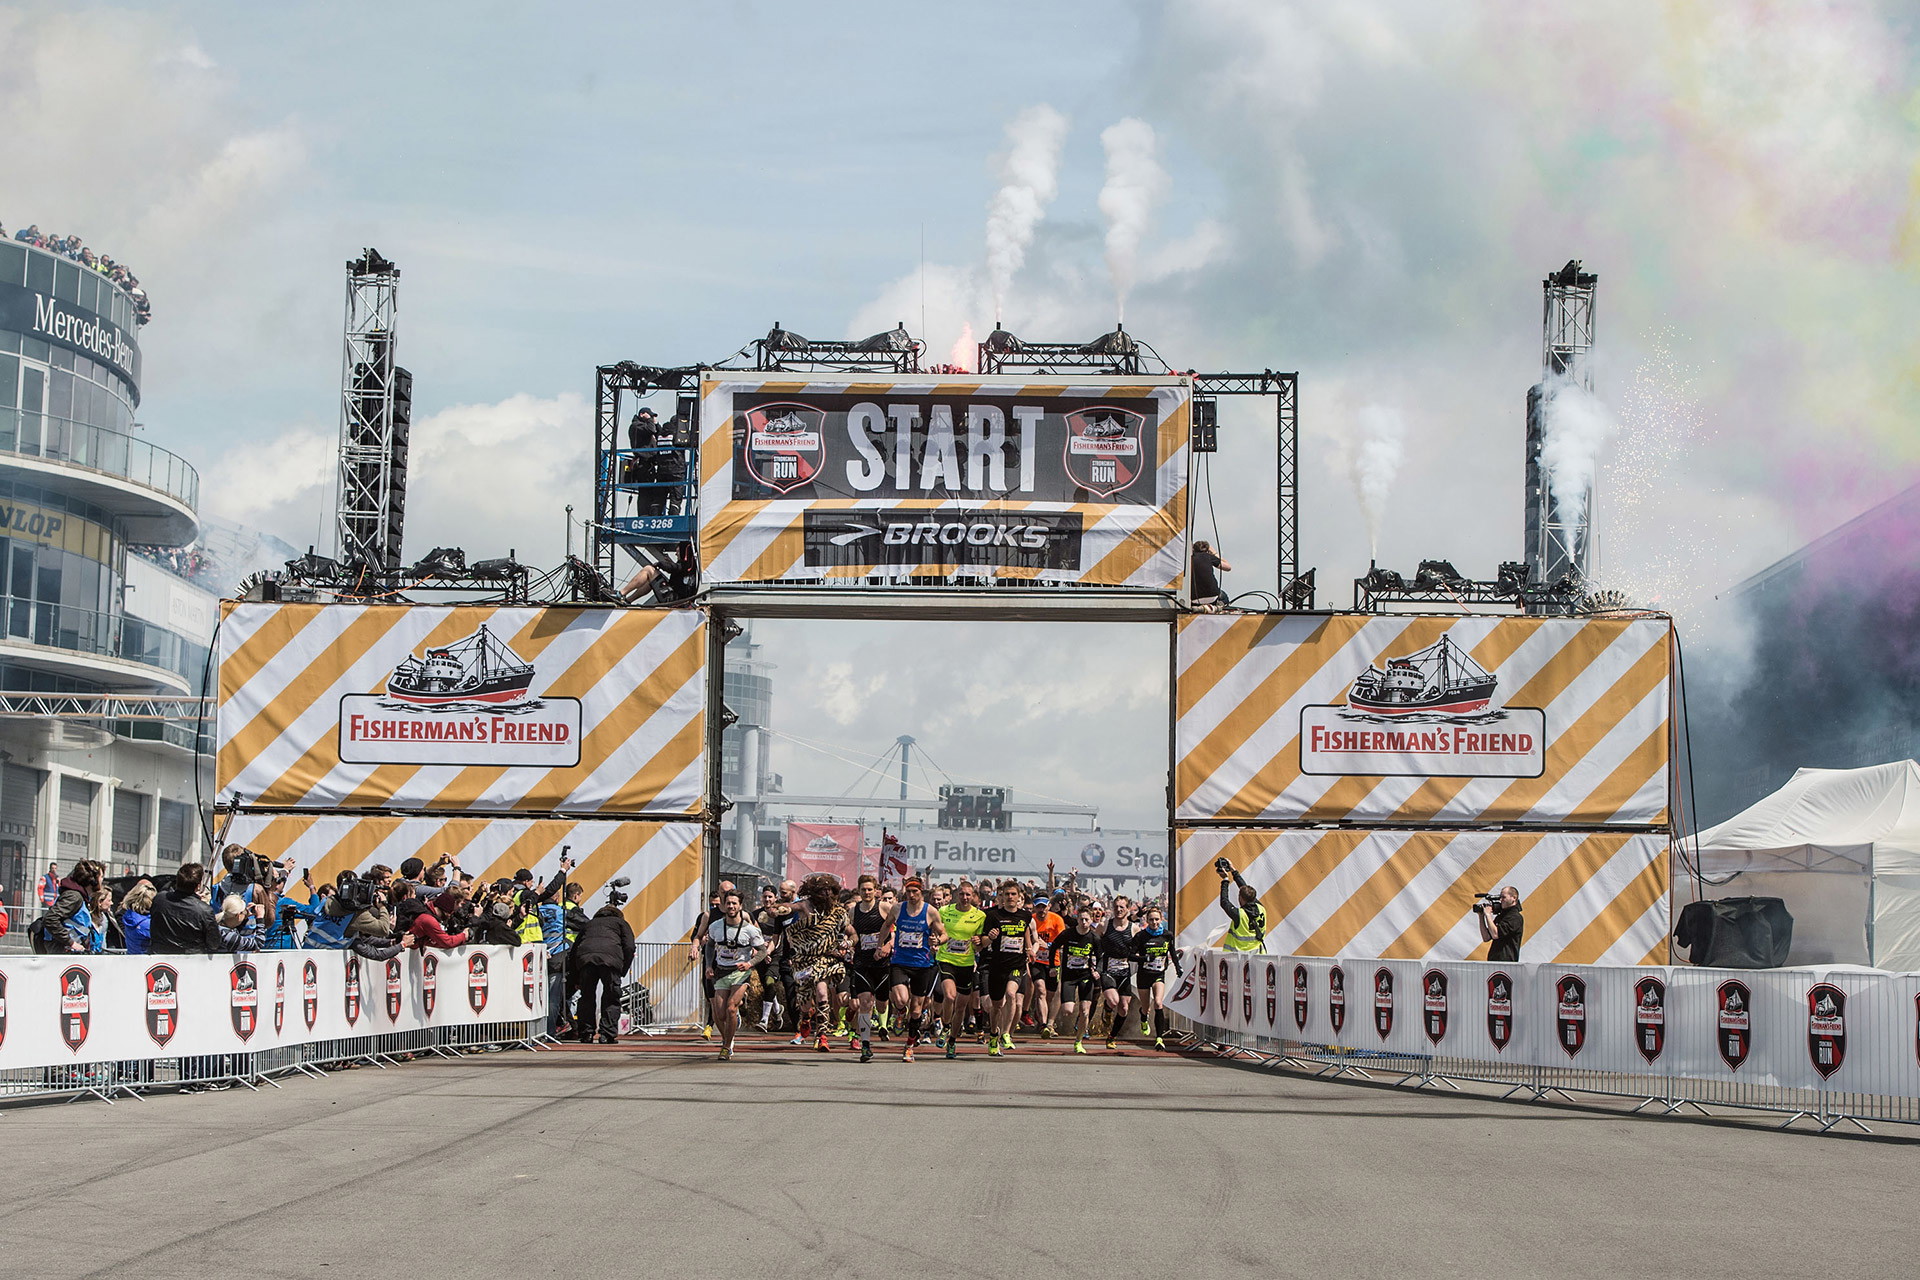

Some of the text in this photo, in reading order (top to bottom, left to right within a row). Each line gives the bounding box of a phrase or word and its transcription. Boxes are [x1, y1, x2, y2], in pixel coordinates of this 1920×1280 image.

[33, 293, 134, 375] Mercedes-Benz
[754, 437, 816, 446] FISHERMAN'S FRIEND
[845, 401, 1045, 492] START
[1073, 441, 1134, 451] FISHERMAN'S FRIEND
[773, 462, 797, 478] RUN
[1091, 466, 1116, 483] RUN
[631, 519, 644, 529] GS
[650, 518, 674, 529] 3268
[883, 522, 1050, 548] BROOKS
[350, 714, 570, 744] FISHERMAN'S FRIEND
[1311, 725, 1533, 755] FISHERMAN'S FRIEND
[934, 840, 1016, 863] Fahren
[1116, 846, 1168, 868] She
